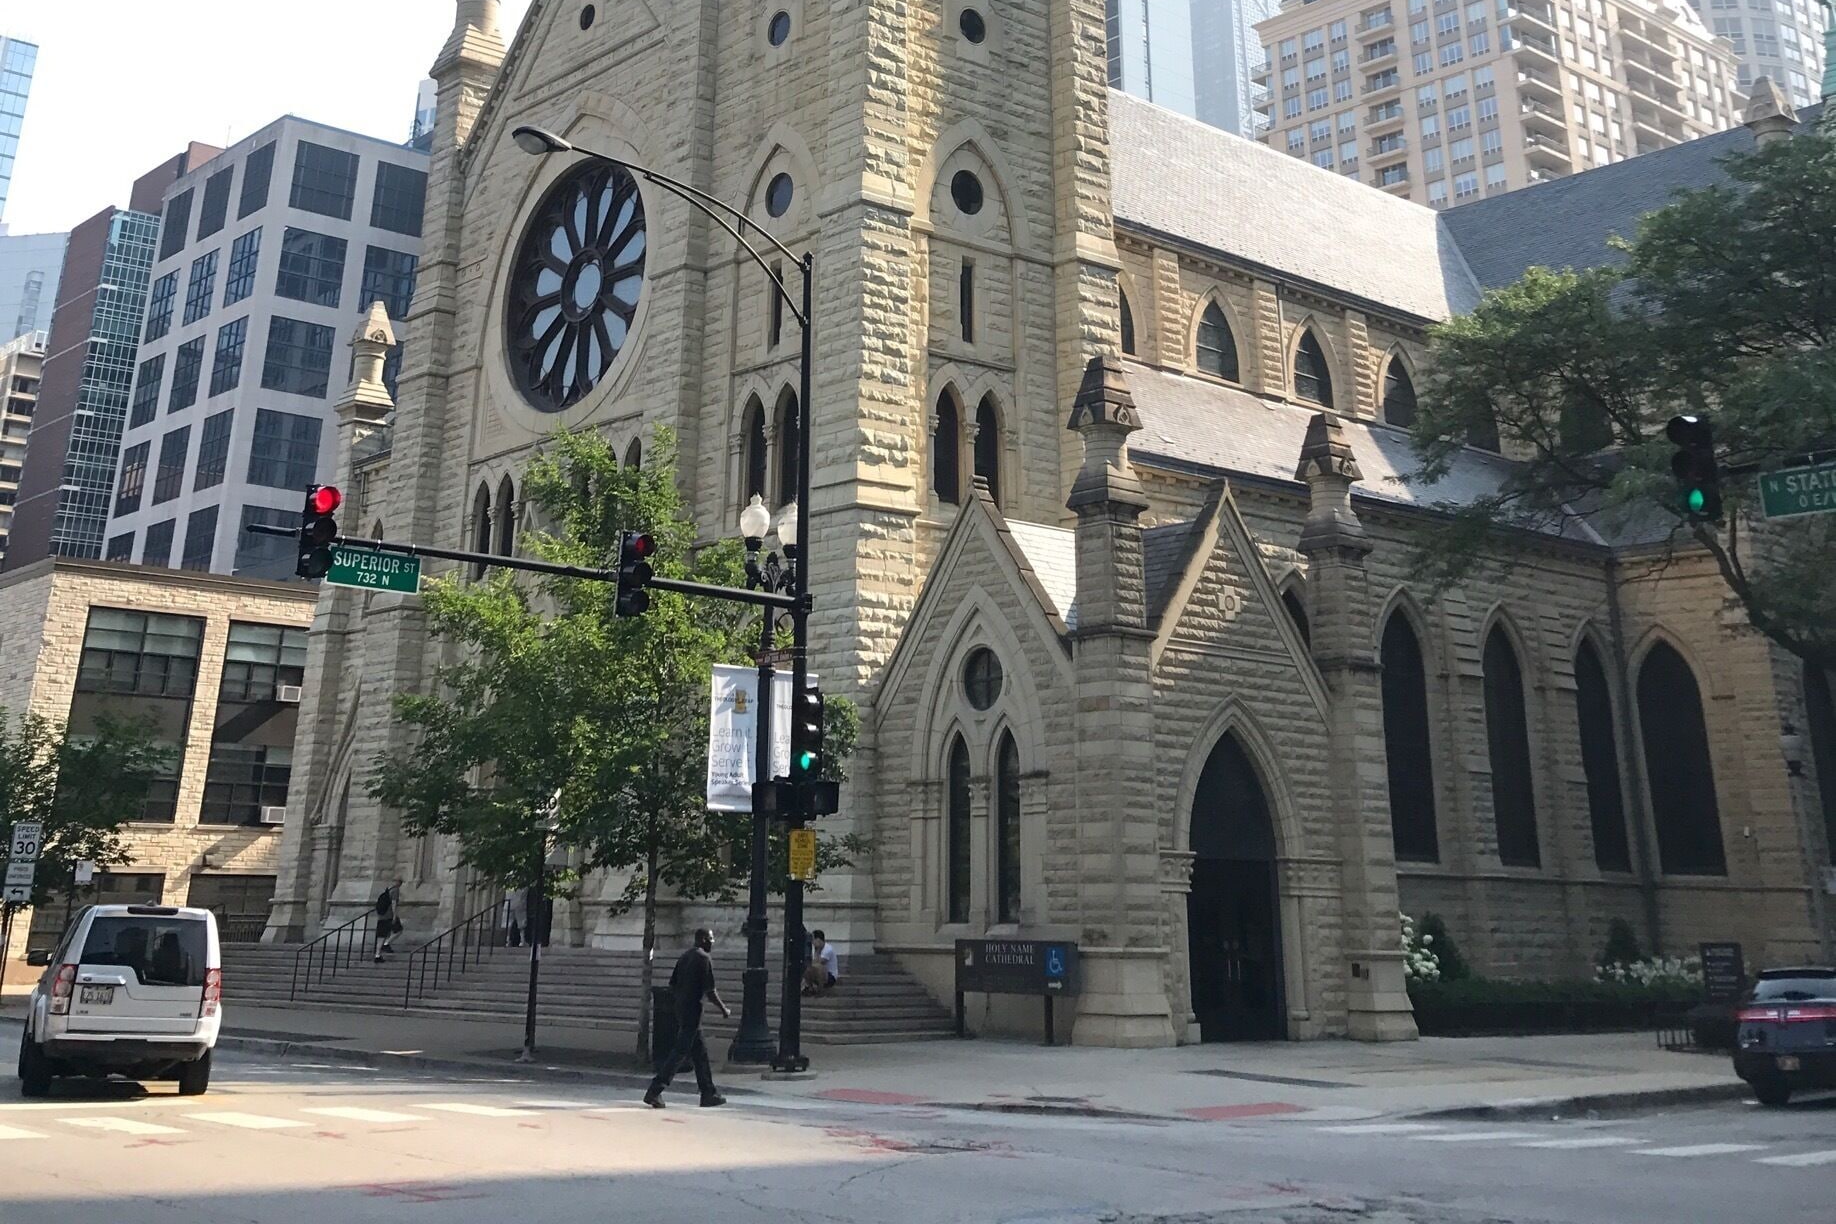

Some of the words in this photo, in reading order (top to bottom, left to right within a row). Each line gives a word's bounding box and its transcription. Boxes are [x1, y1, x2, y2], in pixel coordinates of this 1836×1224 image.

[333, 551, 399, 573] SUPERIOR
[403, 563, 416, 574] ST
[356, 572, 377, 585] 732
[381, 575, 390, 586] N
[712, 727, 742, 738] Learn
[711, 740, 741, 752] Grow
[711, 754, 742, 767] Serve
[14, 841, 35, 854] 30
[985, 943, 1008, 953] HOLY
[1010, 944, 1033, 953] NAME
[985, 954, 1034, 965] CATHEDRAL
